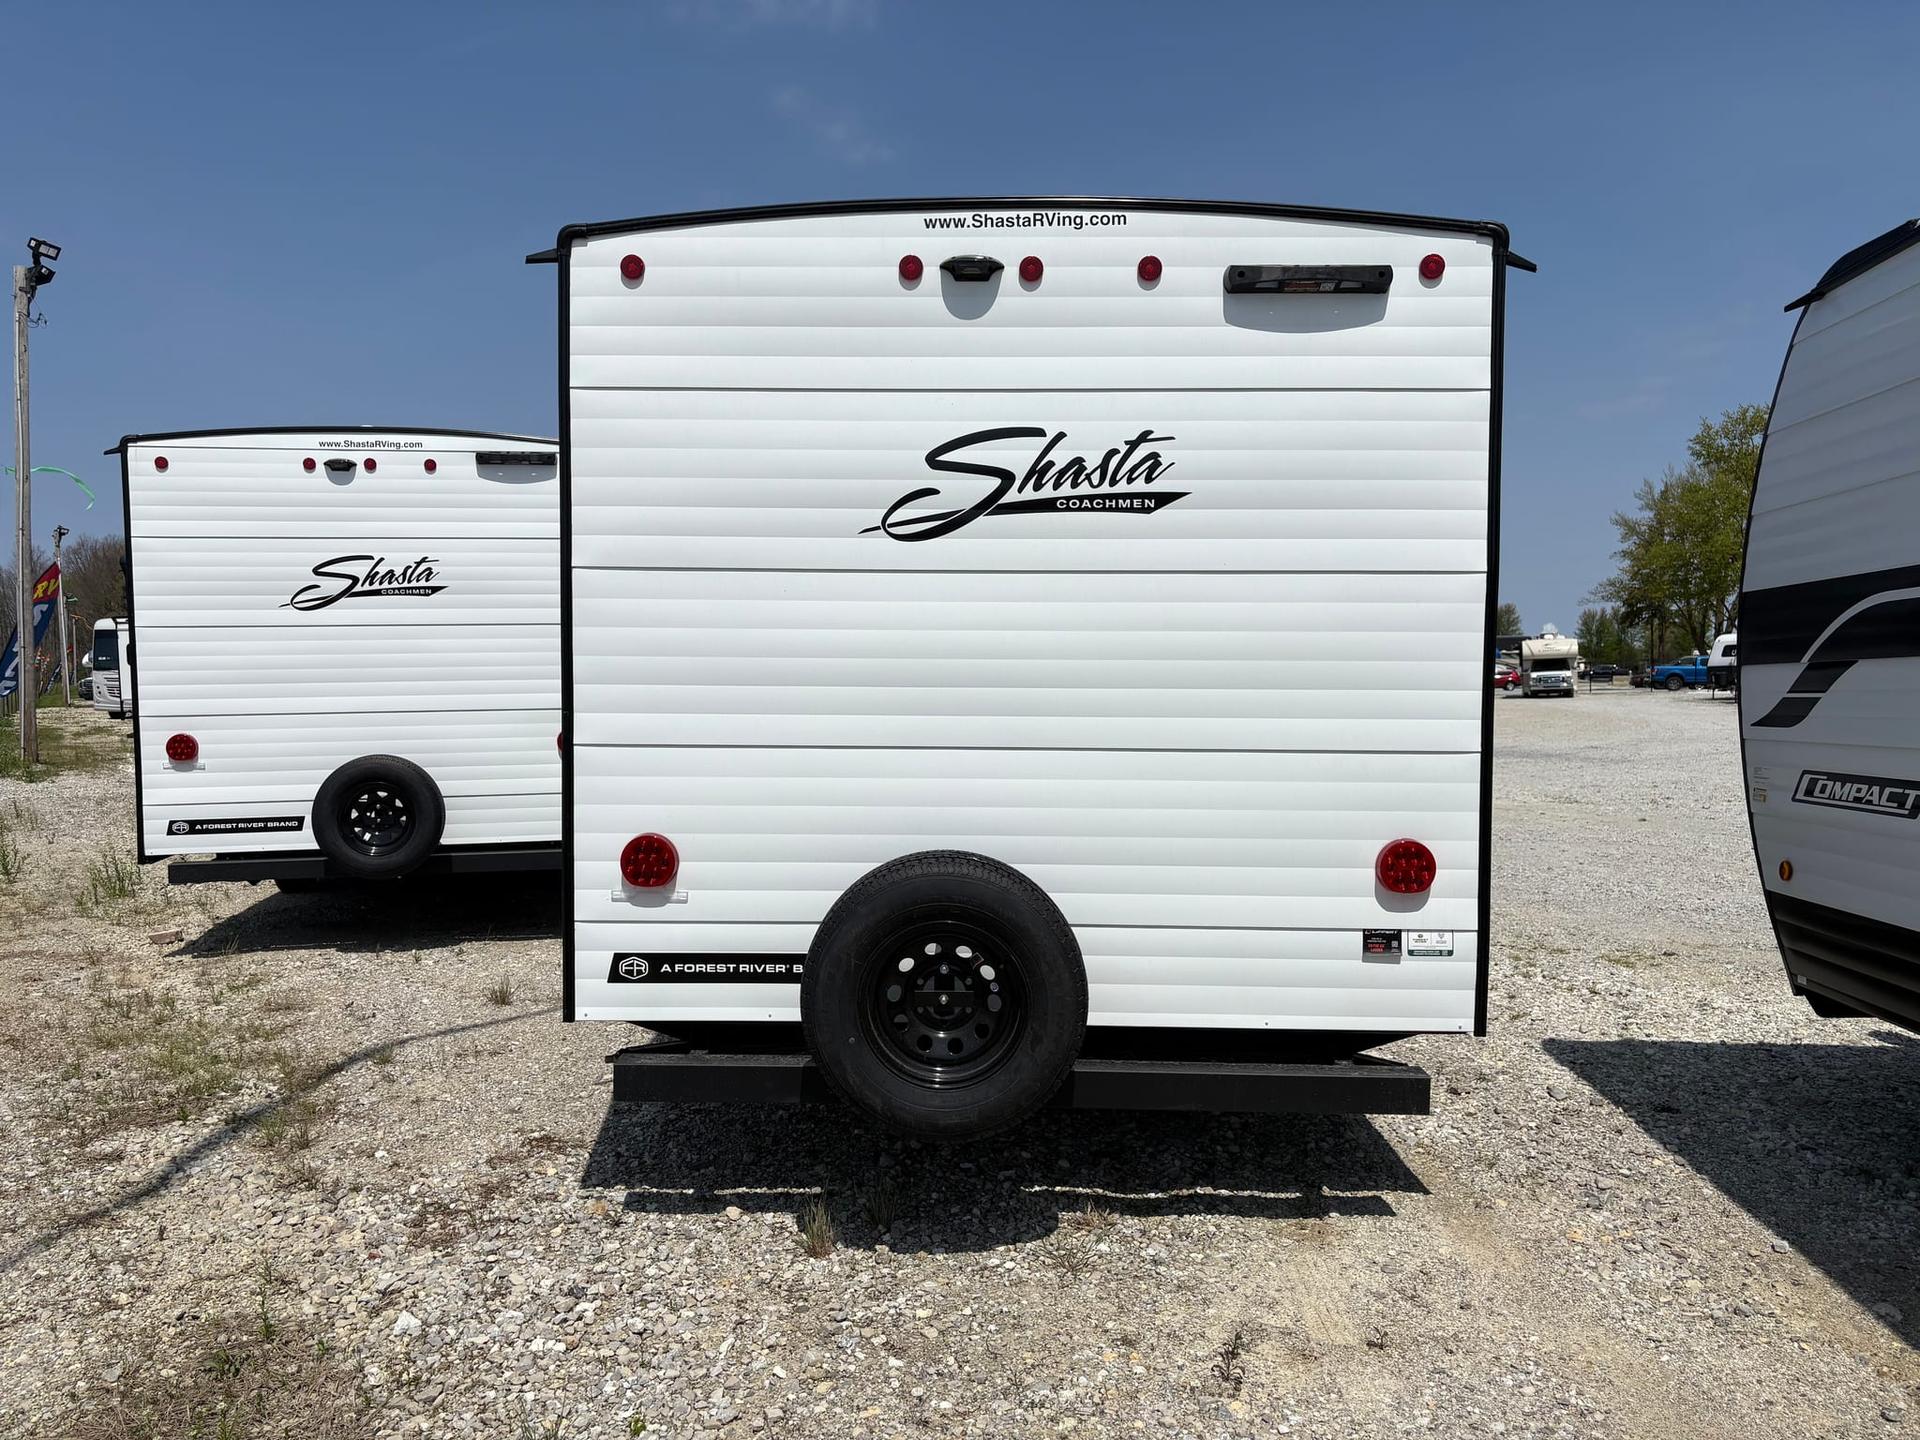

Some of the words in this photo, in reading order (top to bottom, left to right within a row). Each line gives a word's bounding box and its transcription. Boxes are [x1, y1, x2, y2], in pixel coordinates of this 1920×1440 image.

[923, 212, 1127, 230] www.ShastaRVing.com
[319, 439, 423, 449] www.ShastaRVing.com
[879, 426, 1176, 542] Shasta
[1056, 498, 1156, 509] COACHMEN
[32, 579, 59, 599] RV
[290, 554, 440, 611] Shasta
[1795, 773, 1920, 815] COMPACT
[660, 963, 672, 973] A
[675, 963, 737, 973] FOREST
